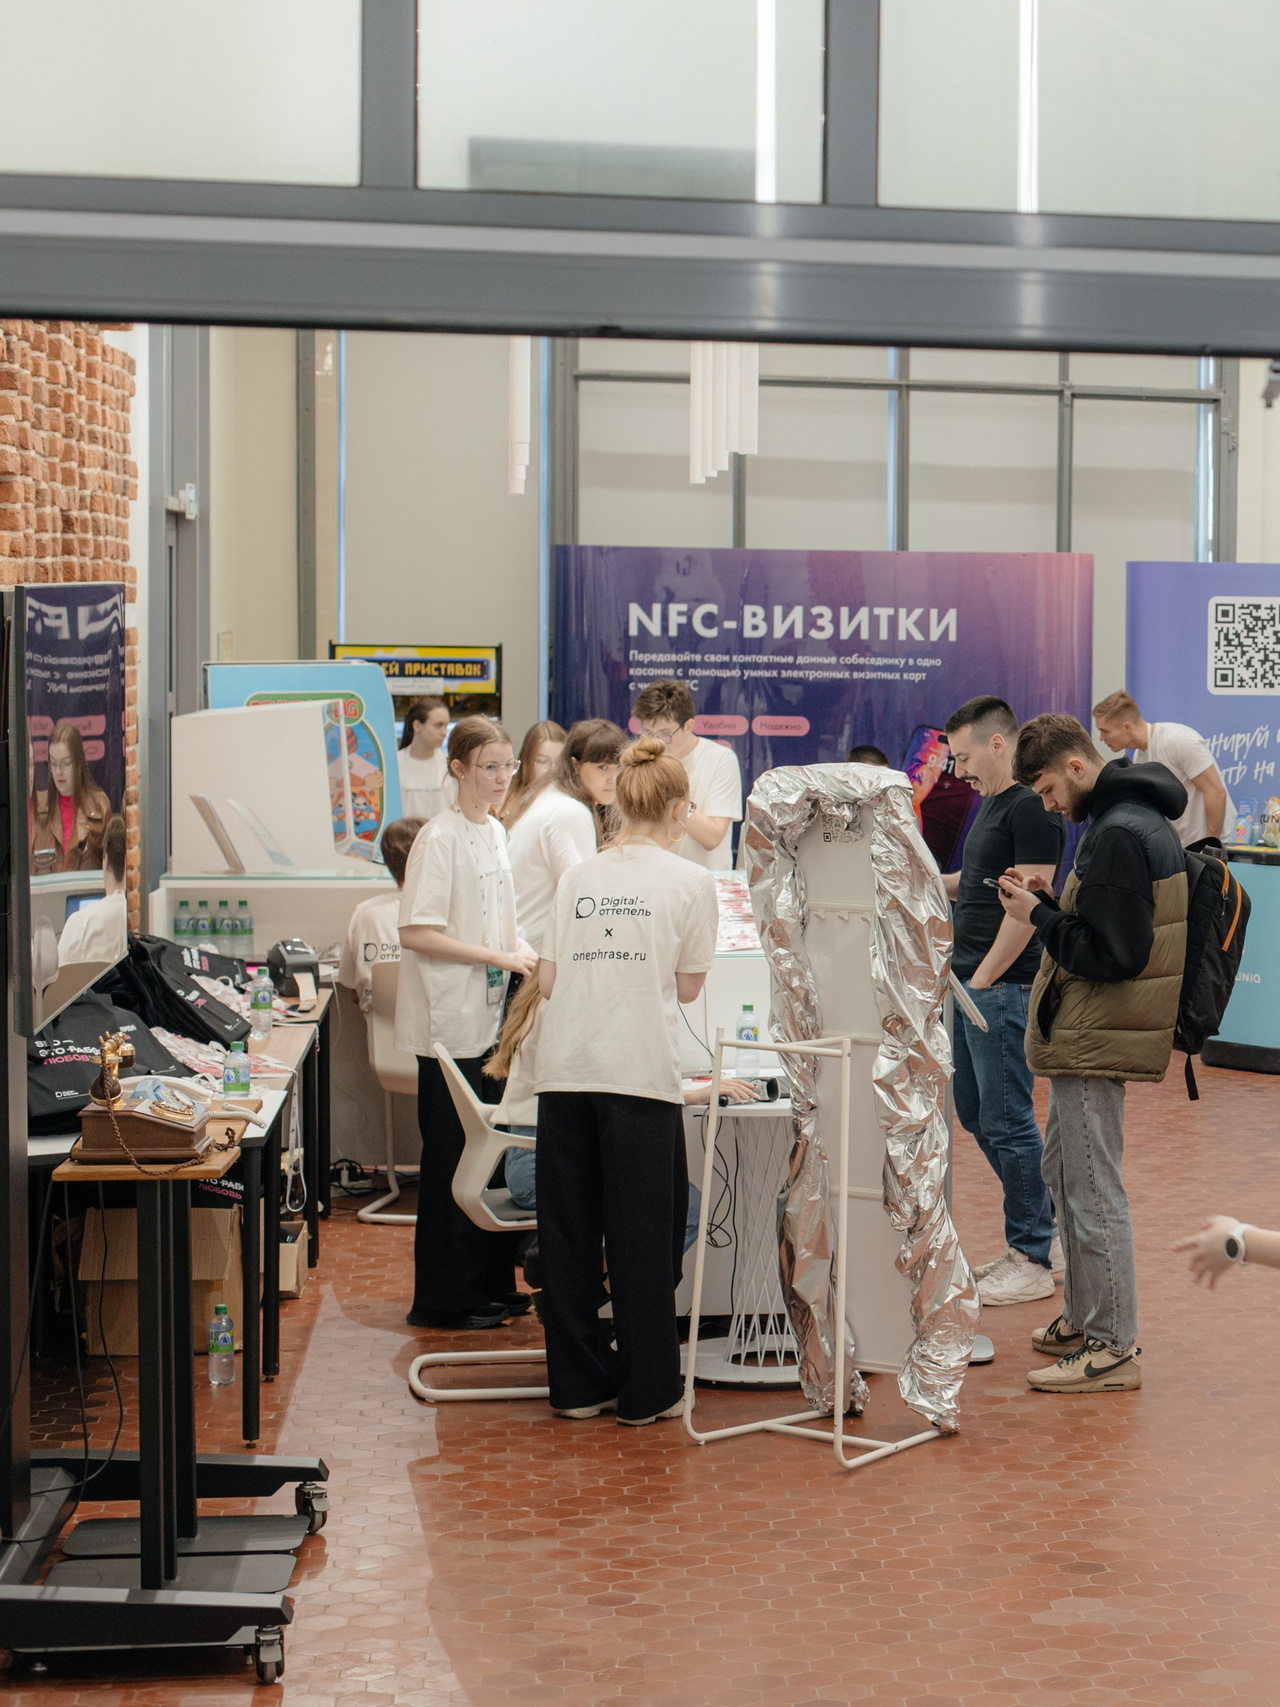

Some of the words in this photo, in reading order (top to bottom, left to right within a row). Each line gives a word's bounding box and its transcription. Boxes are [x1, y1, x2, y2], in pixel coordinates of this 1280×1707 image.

[628, 602, 957, 641] NFC-ВИЗИТКИ
[628, 650, 701, 664] Передавайте
[703, 653, 729, 662] свои
[732, 654, 794, 663] контактные
[796, 655, 837, 665] данные
[839, 653, 906, 668] собеседнику
[908, 657, 914, 665] в
[916, 657, 942, 667] одно
[404, 662, 481, 676] ПРИСТАВОК
[628, 668, 675, 677] касание
[676, 668, 684, 677] с
[688, 668, 741, 678] помощью
[743, 669, 778, 680] умных
[780, 668, 850, 681] электронных
[852, 670, 901, 681] визитных
[903, 671, 927, 683] карт
[628, 682, 635, 691] с
[702, 719, 737, 730] Удобно
[760, 721, 802, 731] Надежно
[1253, 760, 1275, 784] на
[598, 907, 652, 917] оттепель
[381, 942, 400, 952] Digi
[572, 949, 647, 962] onephrase.ru
[43, 1053, 91, 1065] ЛЮБОВ
